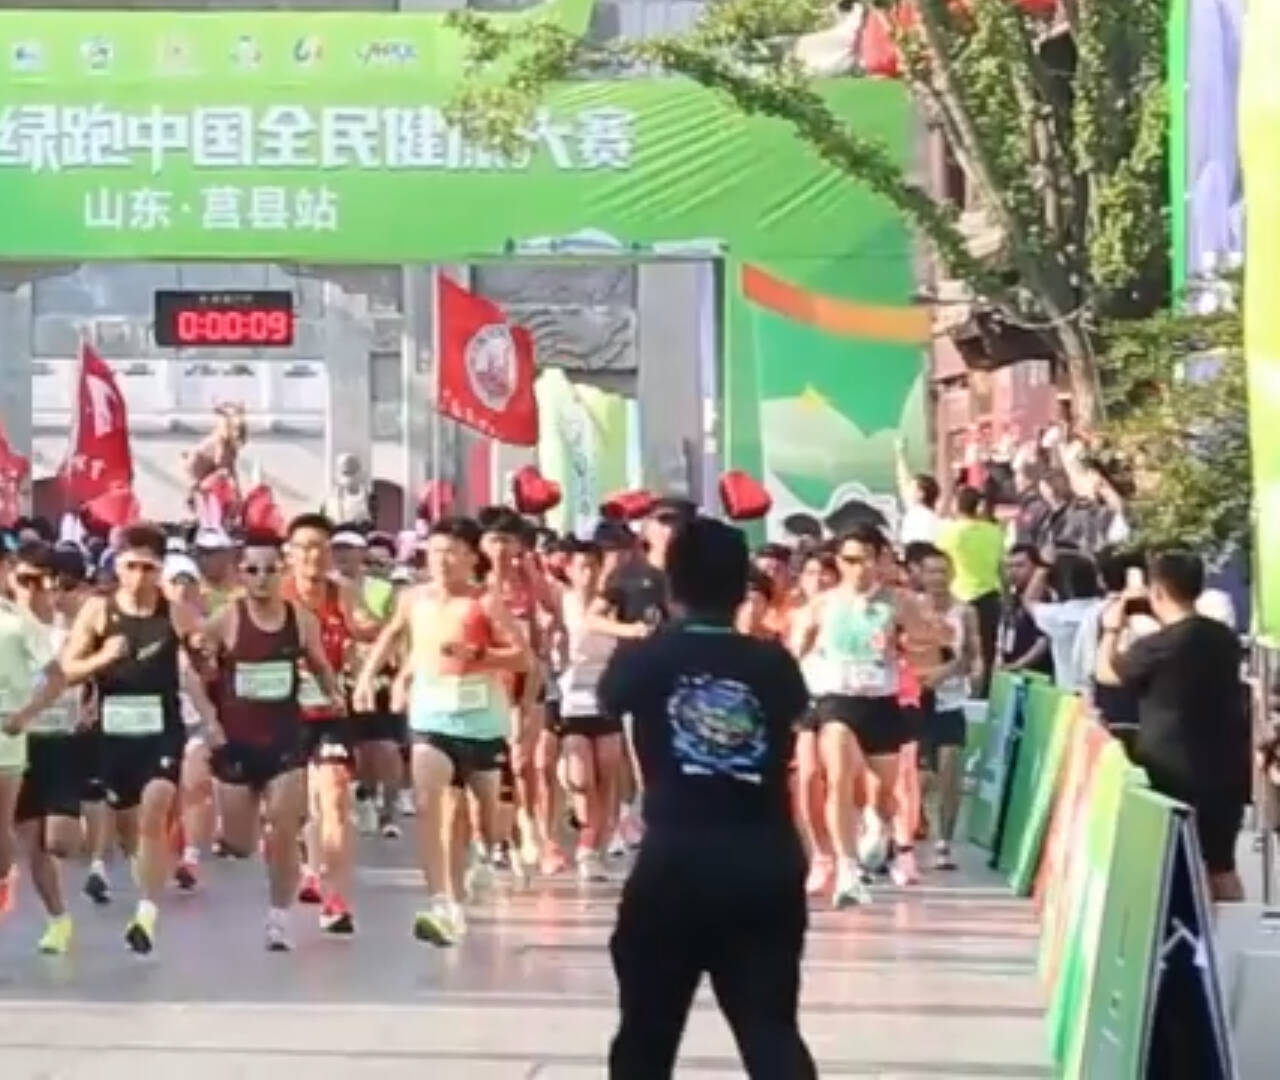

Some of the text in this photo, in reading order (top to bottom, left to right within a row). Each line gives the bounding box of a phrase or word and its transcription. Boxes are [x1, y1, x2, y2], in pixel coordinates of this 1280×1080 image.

[84, 184, 339, 232] 山东·莒县站
[178, 310, 289, 341] 0:00:09
